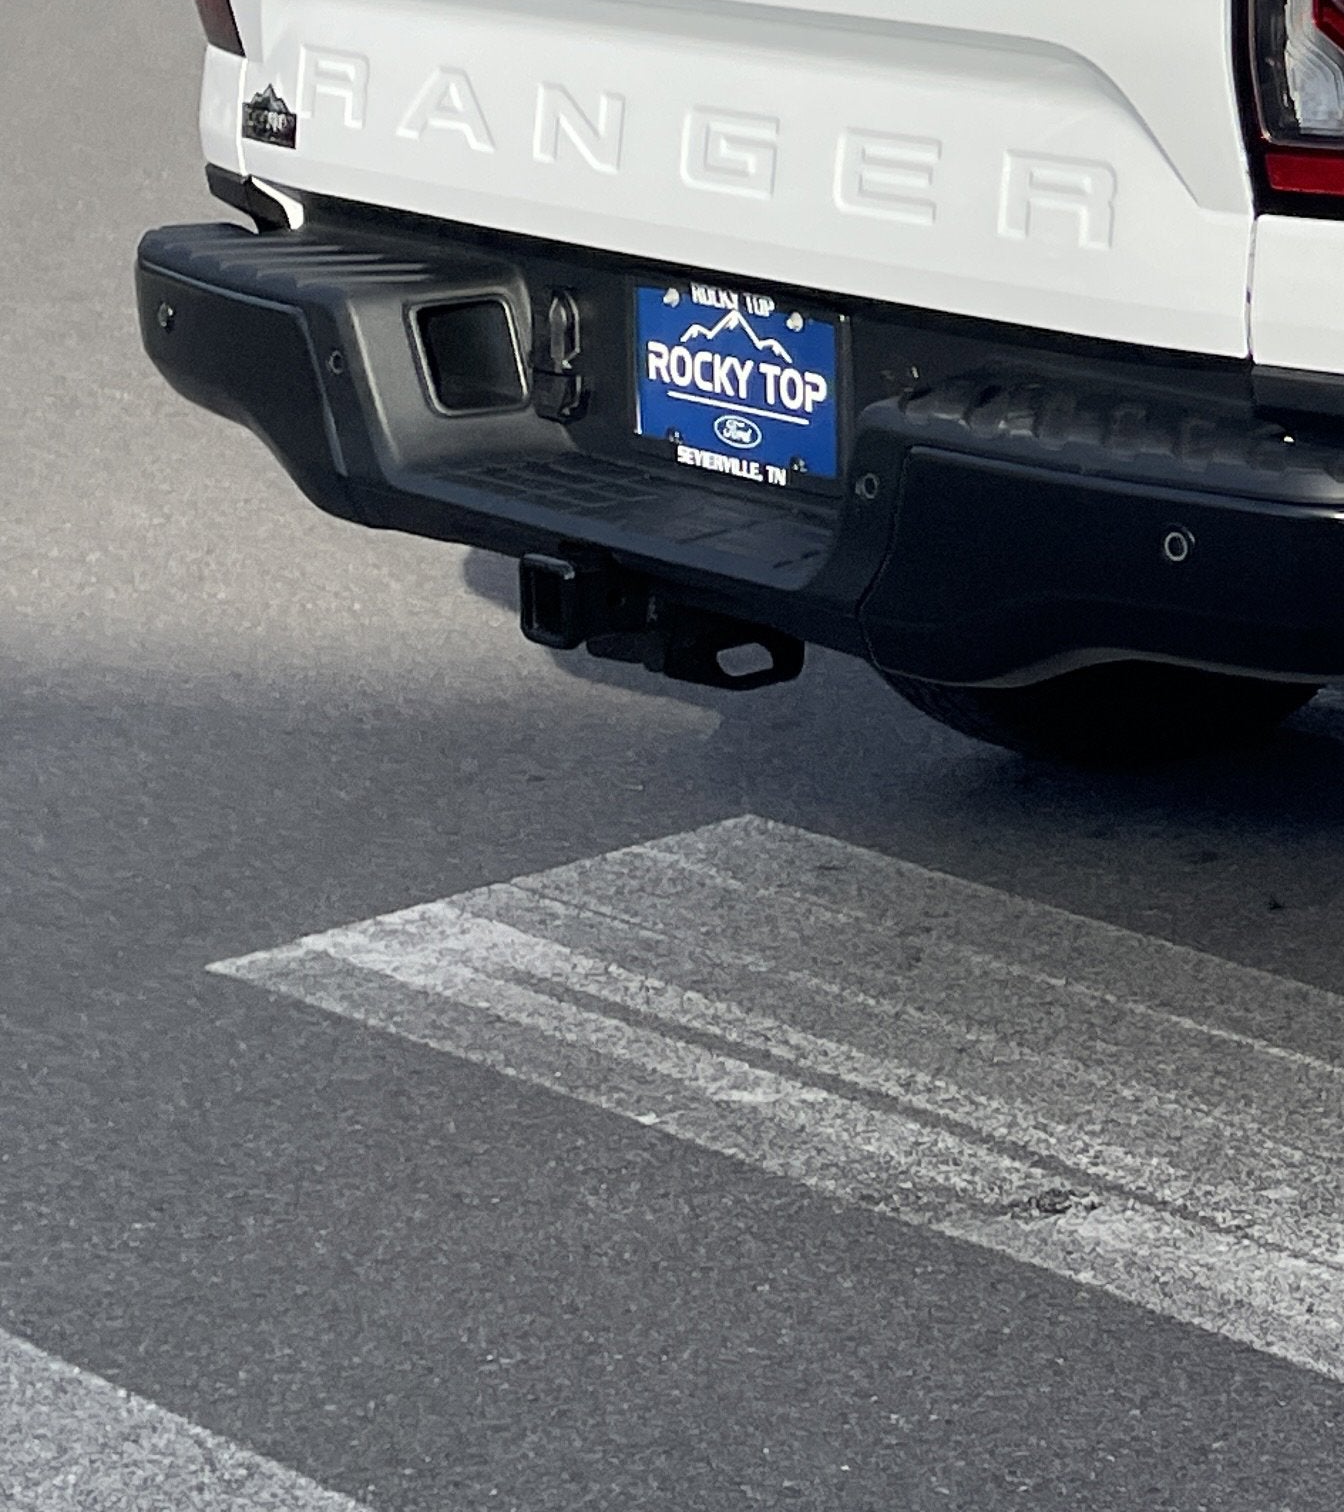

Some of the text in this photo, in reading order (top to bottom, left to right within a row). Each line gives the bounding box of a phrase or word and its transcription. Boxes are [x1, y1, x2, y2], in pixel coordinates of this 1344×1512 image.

[297, 42, 1117, 250] RANGER
[690, 282, 775, 317] ROCKY TOP
[647, 341, 827, 413] ROCKY TOP
[723, 419, 752, 443] Ford
[766, 465, 787, 486] TN
